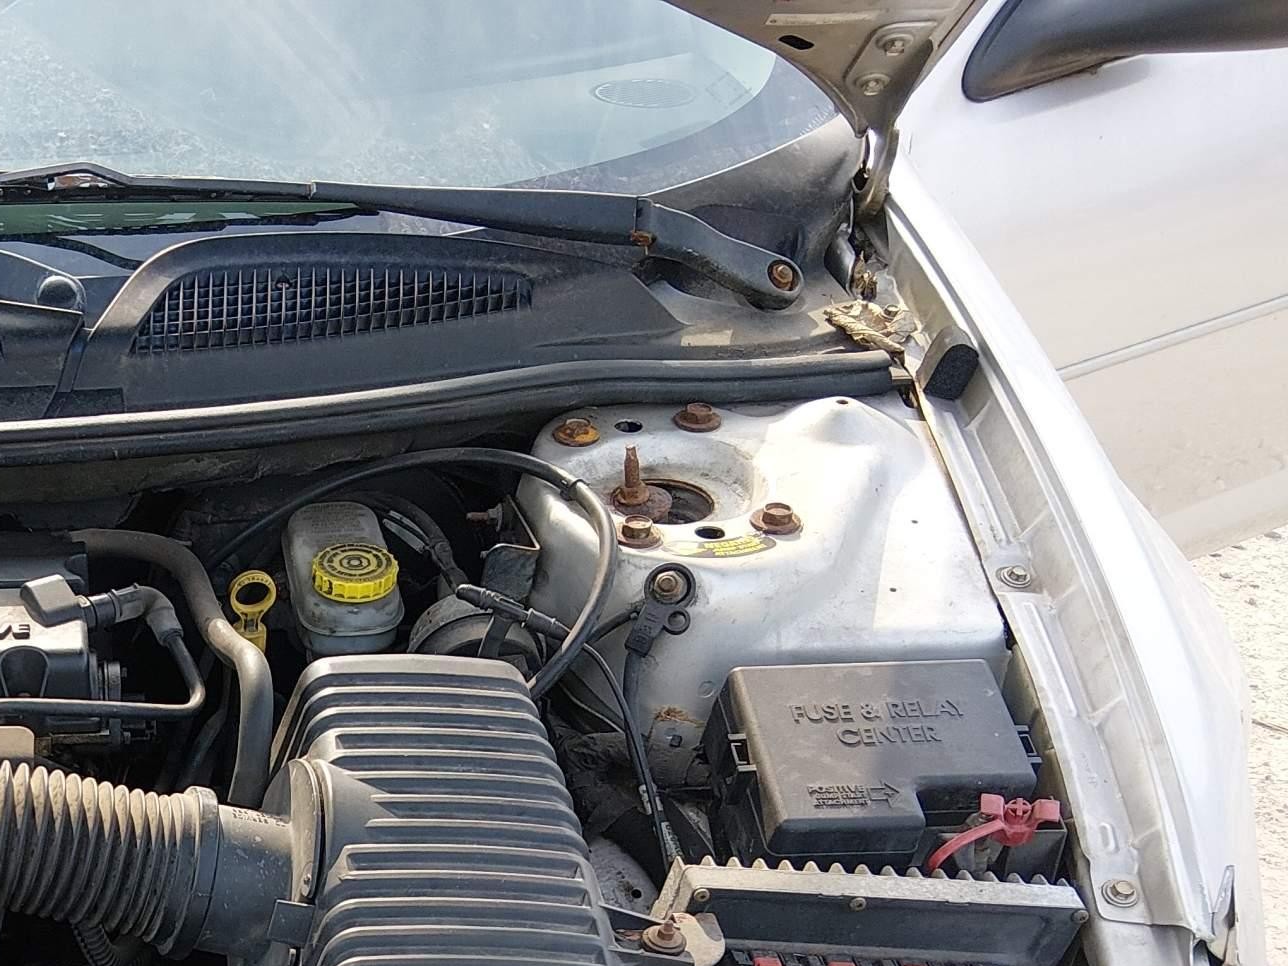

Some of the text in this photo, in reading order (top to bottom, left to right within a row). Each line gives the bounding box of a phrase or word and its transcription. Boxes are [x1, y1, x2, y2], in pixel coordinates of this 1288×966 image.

[789, 699, 964, 725] FUSE & RELAY
[836, 725, 942, 748] CENTER
[807, 783, 865, 796] POSITIVE
